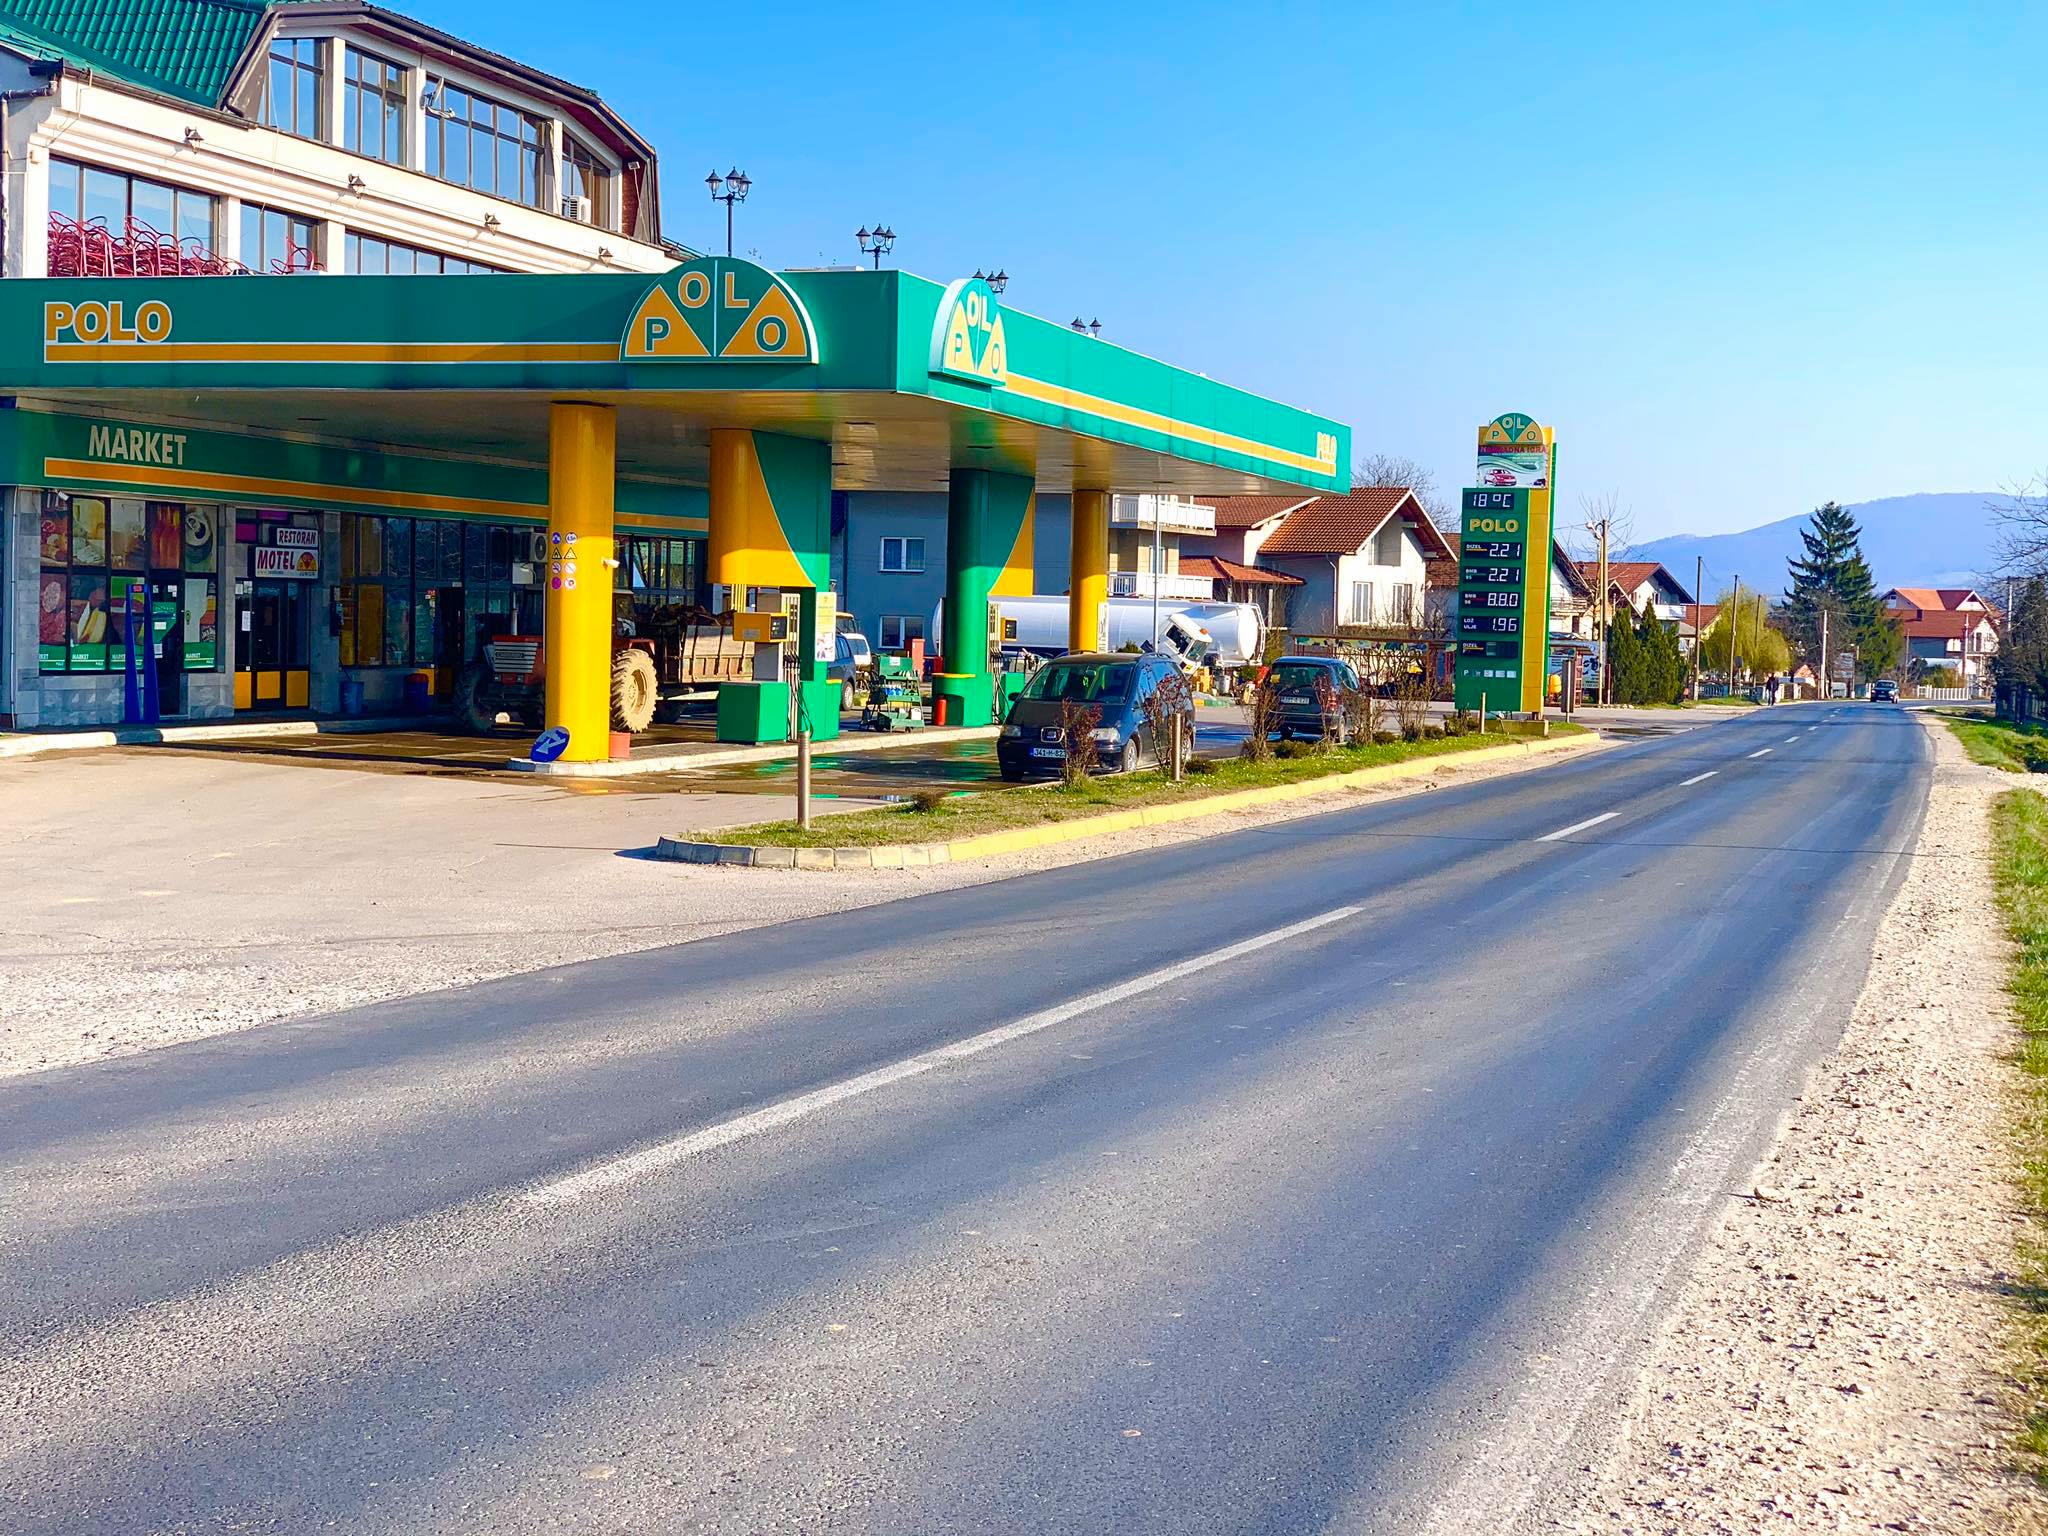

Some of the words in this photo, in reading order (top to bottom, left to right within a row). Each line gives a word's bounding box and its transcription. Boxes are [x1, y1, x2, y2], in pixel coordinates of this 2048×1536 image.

[45, 300, 173, 343] POLO
[88, 424, 187, 466] MARKET
[1473, 493, 1488, 508] 18
[1469, 518, 1519, 533] POLO
[278, 529, 317, 545] RESTORAN
[1489, 543, 1520, 557] 2.21
[257, 549, 295, 570] MOTEL
[1488, 567, 1519, 582] 2.21
[1492, 618, 1517, 631] 1.96
